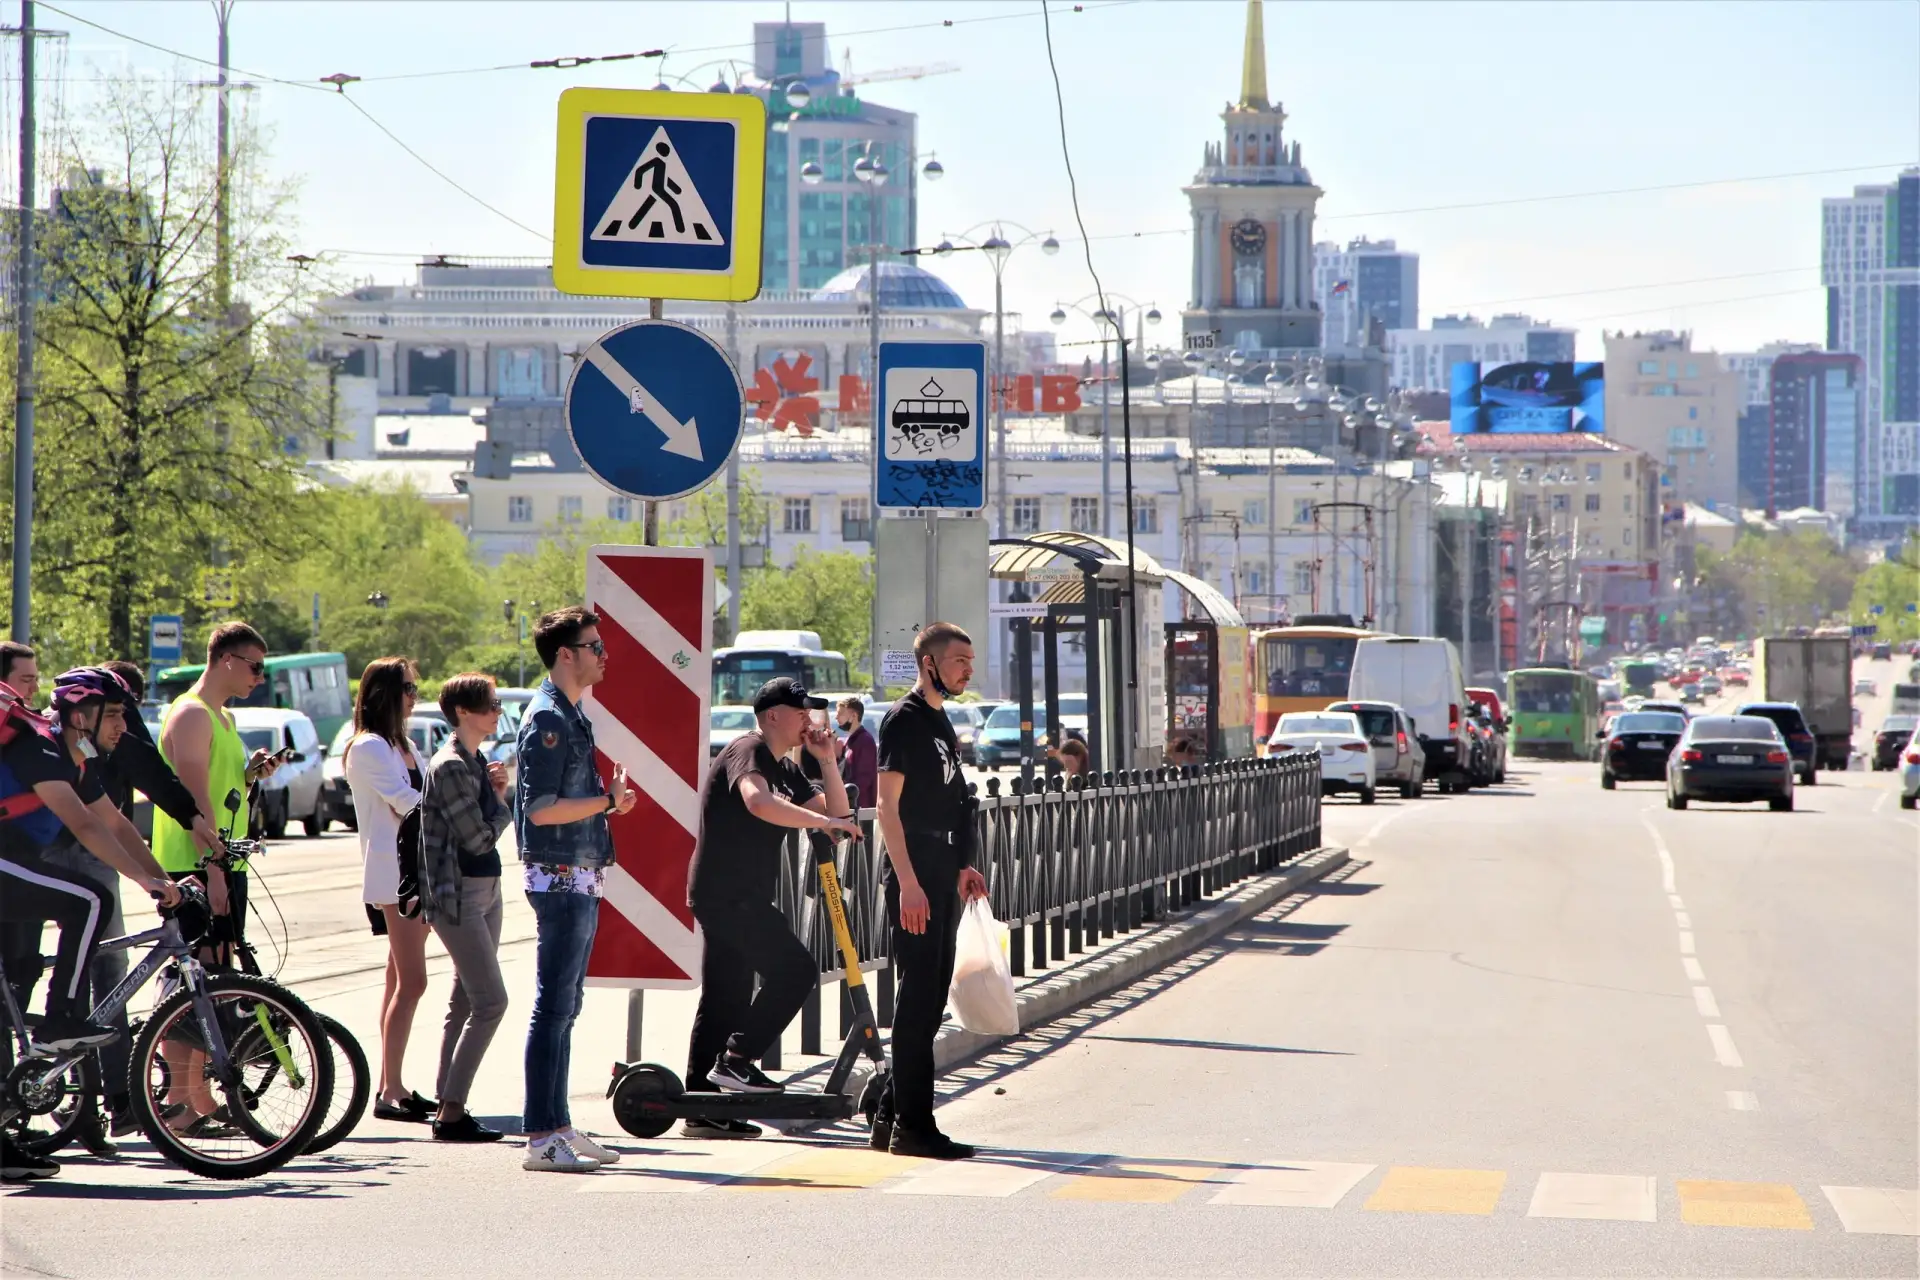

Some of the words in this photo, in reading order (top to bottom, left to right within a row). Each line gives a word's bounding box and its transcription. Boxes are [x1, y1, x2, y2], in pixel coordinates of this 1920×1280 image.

[1187, 335, 1213, 349] 1135
[839, 374, 1083, 413] МИВ
[825, 870, 841, 913] WHOOSH
